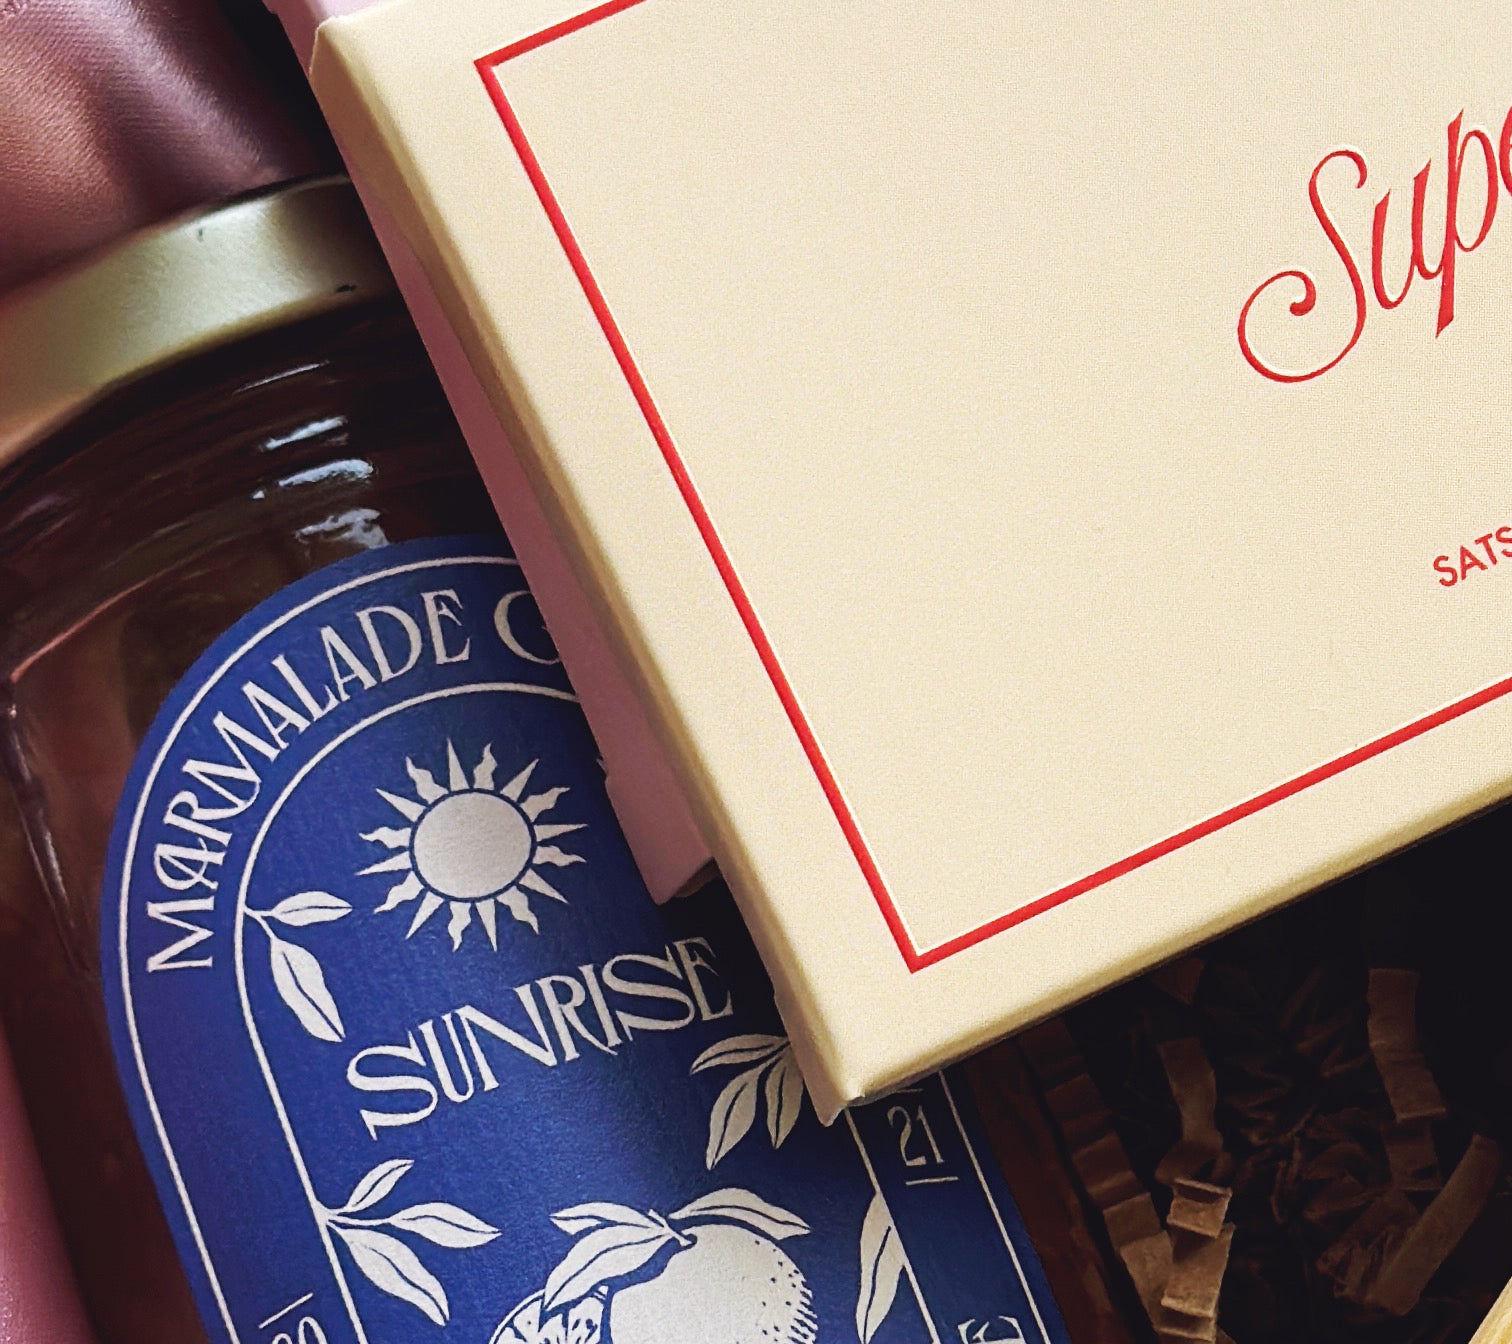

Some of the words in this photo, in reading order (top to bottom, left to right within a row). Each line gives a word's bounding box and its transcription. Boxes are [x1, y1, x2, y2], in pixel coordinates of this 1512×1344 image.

[146, 588, 471, 974] MARMALADE
[345, 936, 734, 1141] SUNRISE
[886, 1104, 945, 1168] 21
